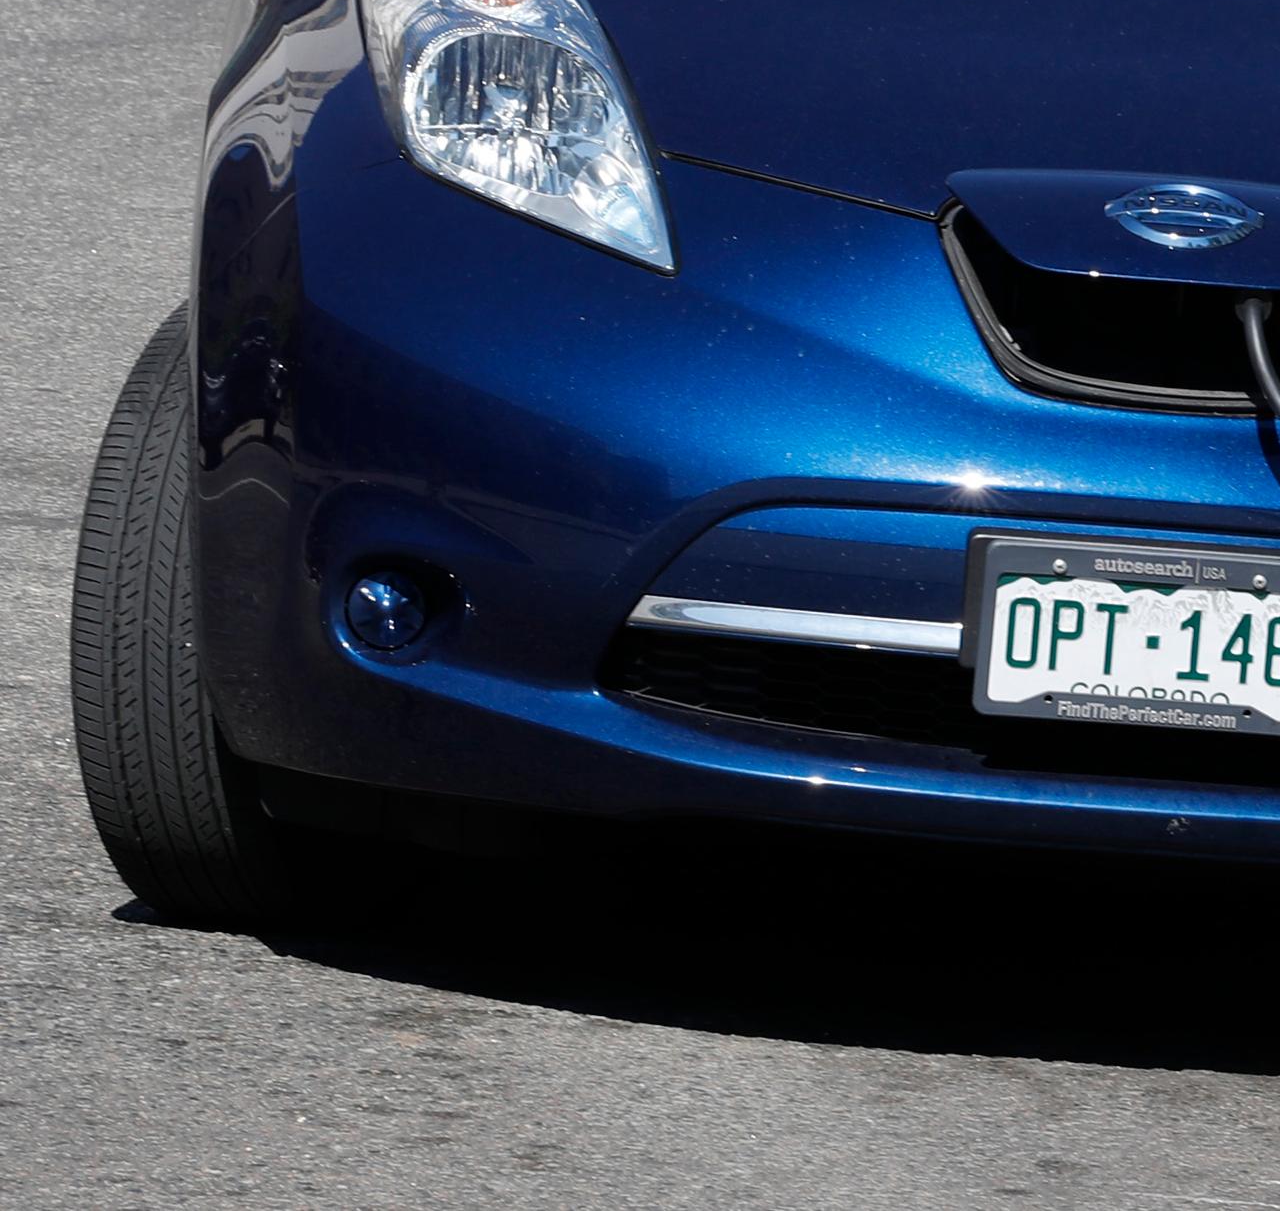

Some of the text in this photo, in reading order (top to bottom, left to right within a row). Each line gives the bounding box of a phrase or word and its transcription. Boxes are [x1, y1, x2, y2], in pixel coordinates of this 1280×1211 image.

[1124, 195, 1248, 218] NISSAN
[1094, 557, 1227, 580] autosearch USA
[1057, 700, 1237, 729] FindThePerfectCar.com
